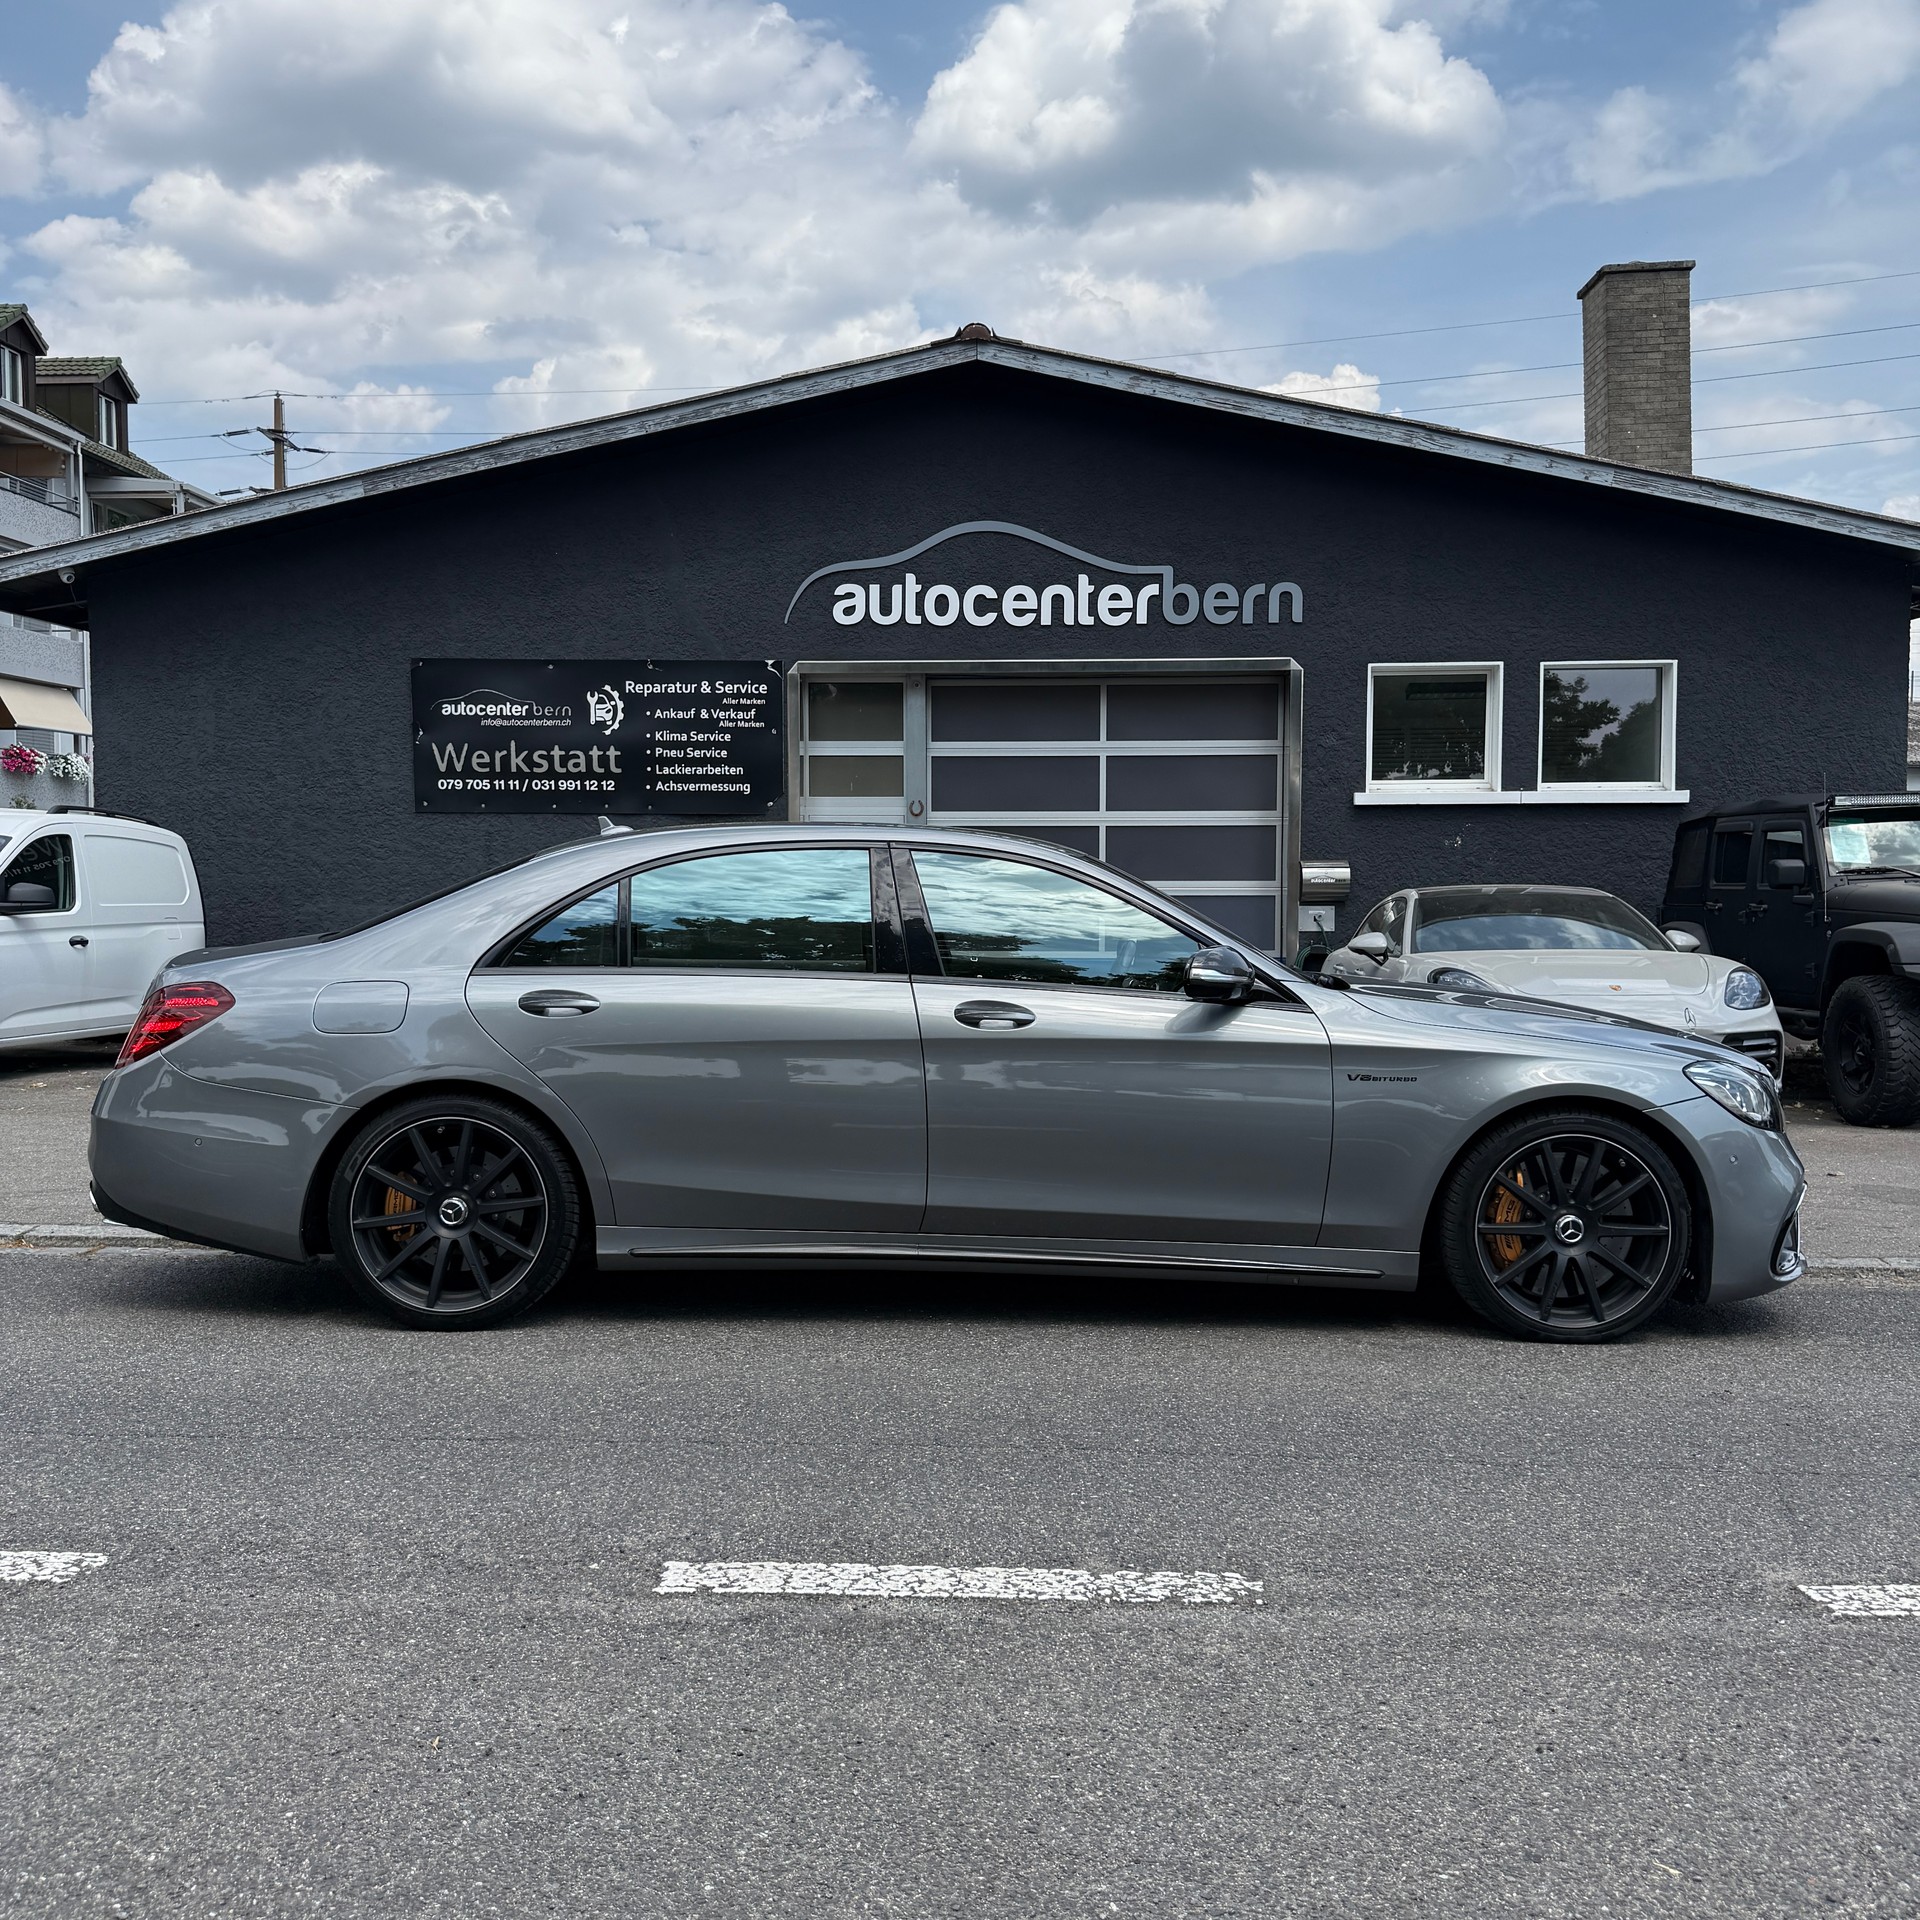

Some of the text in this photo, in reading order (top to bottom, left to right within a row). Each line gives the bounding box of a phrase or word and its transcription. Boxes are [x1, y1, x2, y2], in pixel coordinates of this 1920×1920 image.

[626, 680, 767, 697] Reparatur & Service
[655, 708, 756, 719] Ankauf & Verkauf
[481, 718, 571, 726] info@autocenterbern.ch
[656, 730, 731, 741] Klima Service
[432, 740, 621, 773] Werkstatt
[656, 747, 727, 757] Pneu Service
[656, 764, 743, 775] Lackierarbeiten
[438, 779, 463, 789] 079
[466, 780, 490, 789] 705
[532, 780, 554, 790] 031
[558, 780, 580, 790] 991
[584, 780, 598, 790] 12
[601, 780, 614, 790] 12
[656, 781, 750, 794] Achsvermessung
